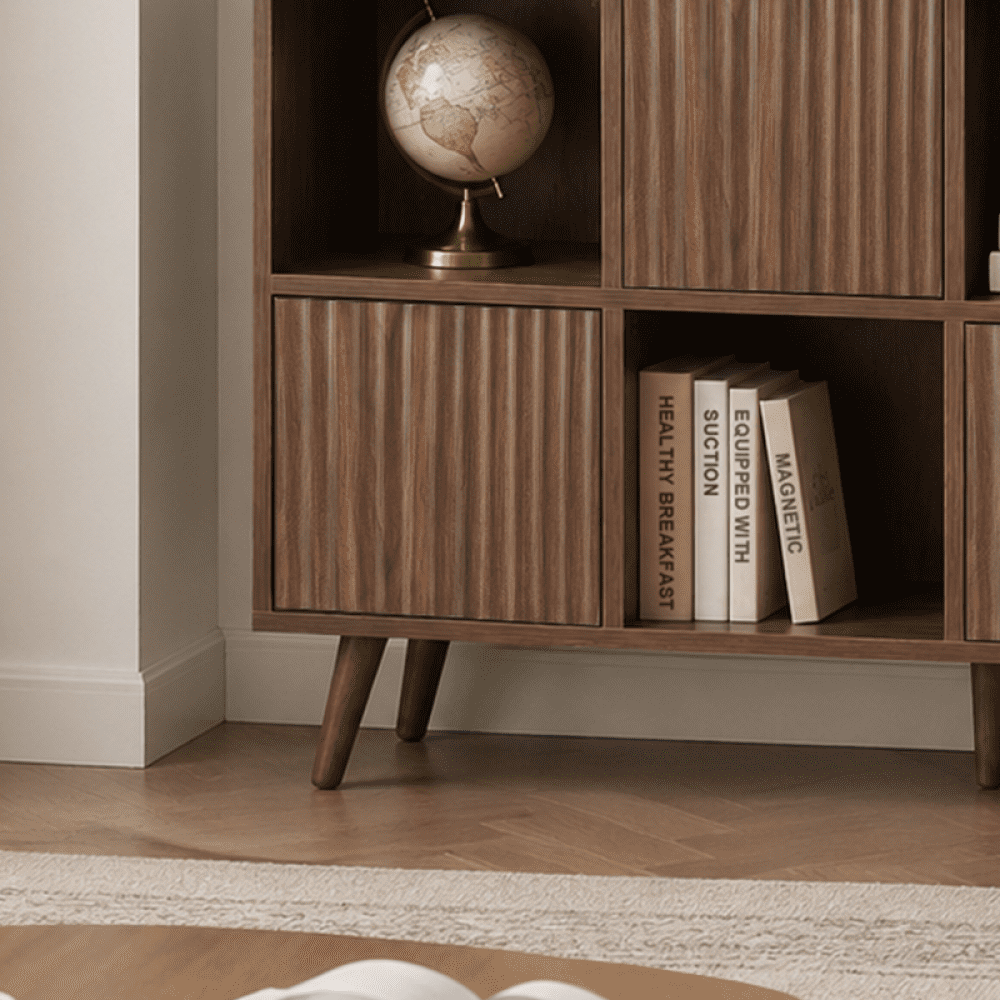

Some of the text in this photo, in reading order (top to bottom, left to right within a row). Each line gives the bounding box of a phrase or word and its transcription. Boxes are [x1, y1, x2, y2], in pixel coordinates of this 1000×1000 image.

[659, 395, 675, 611] HEALTHY BREAKFAST
[703, 409, 720, 496] SUCTION
[734, 409, 750, 563] EQUIPPED WITH
[775, 453, 803, 554] MAGNETIC
